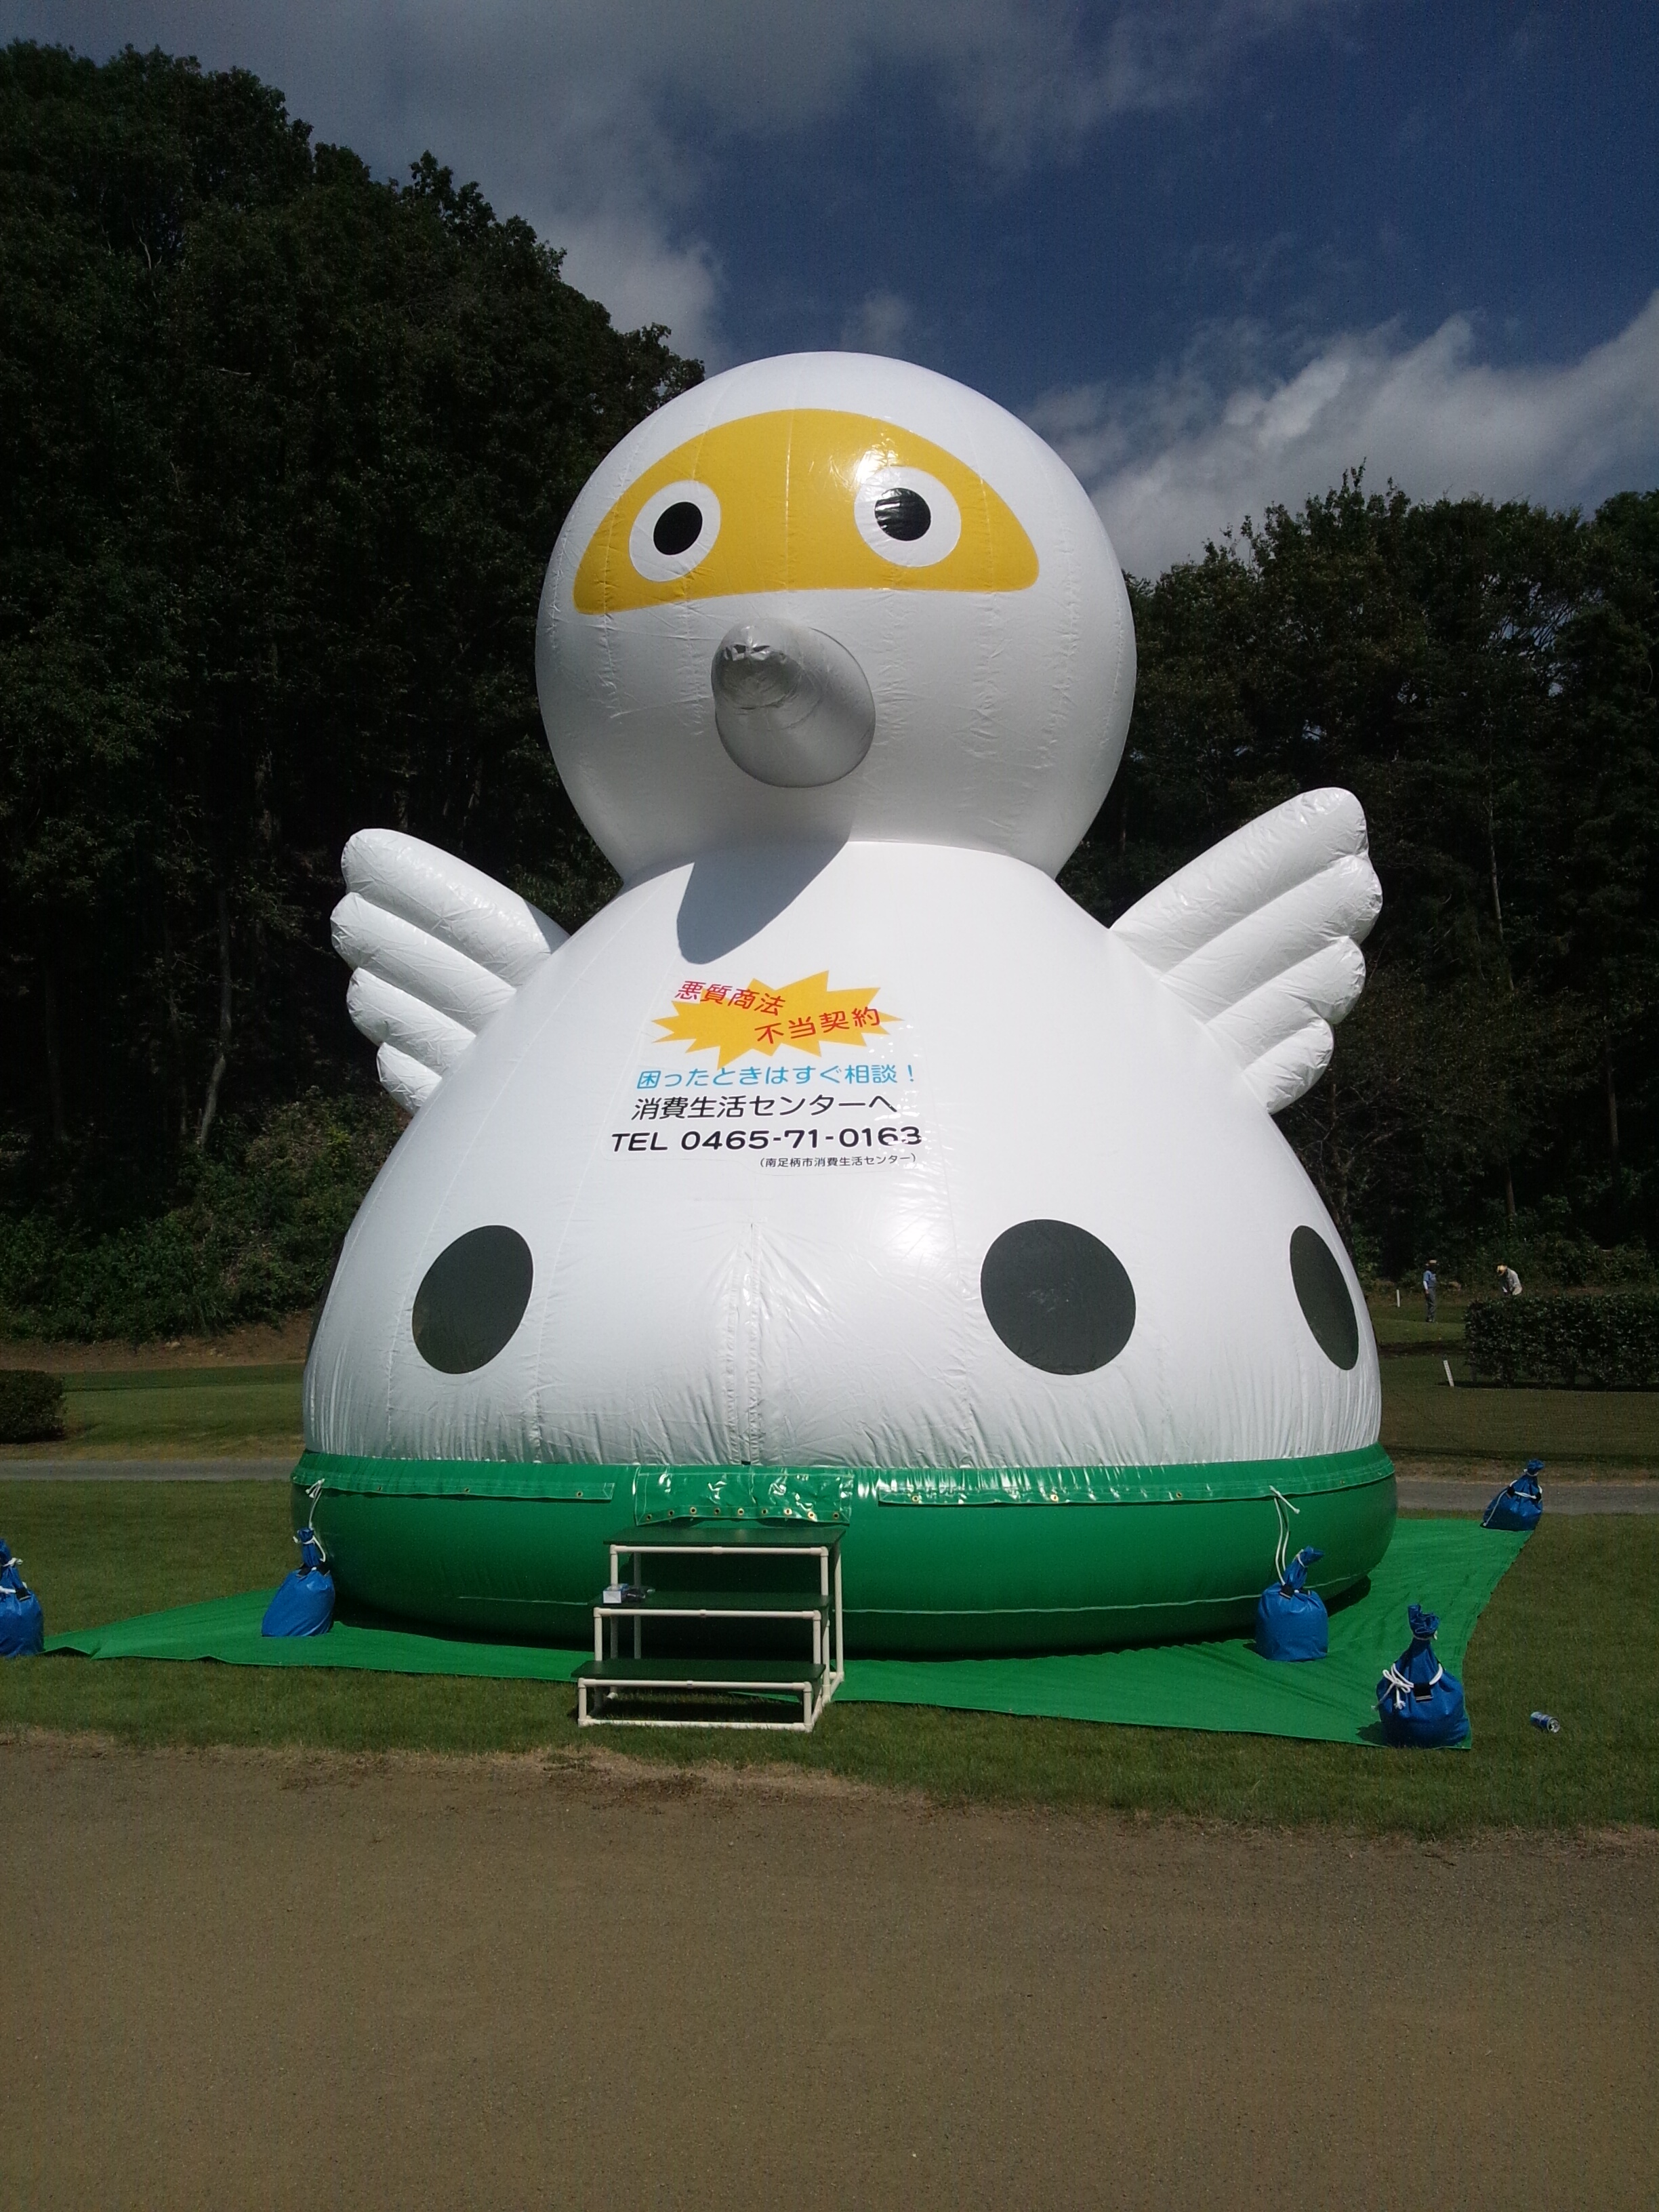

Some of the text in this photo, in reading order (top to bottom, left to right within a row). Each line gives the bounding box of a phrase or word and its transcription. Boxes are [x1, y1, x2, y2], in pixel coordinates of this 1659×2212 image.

[674, 980, 786, 1017] 悪質商法
[754, 1006, 880, 1045] 不当契約
[636, 1064, 916, 1090] 困ったときはすぐ相談！
[631, 1094, 898, 1121] 消費生活センターへ
[611, 1126, 922, 1153] TEL 0465-71-0163
